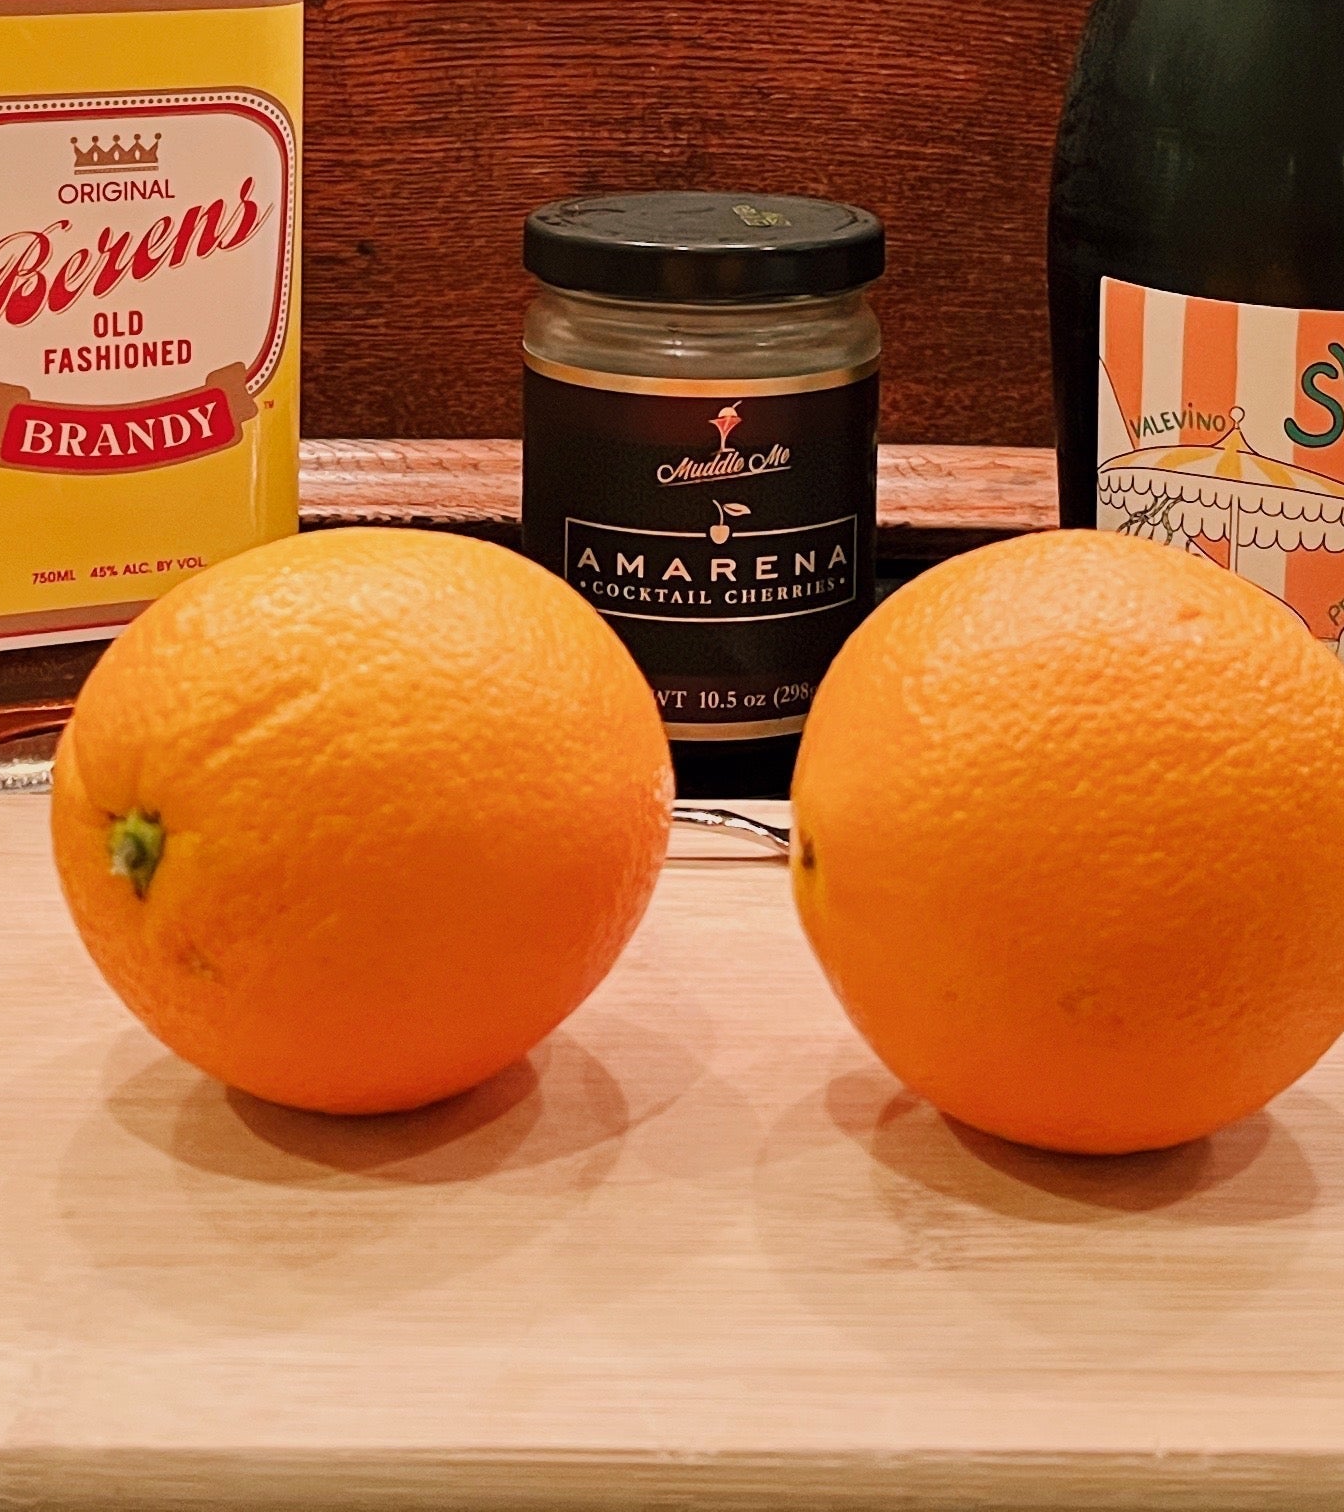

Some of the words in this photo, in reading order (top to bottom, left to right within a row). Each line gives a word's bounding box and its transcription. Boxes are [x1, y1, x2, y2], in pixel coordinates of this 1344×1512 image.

[58, 178, 175, 204] ORIGINAL
[93, 310, 143, 338] OLD
[44, 339, 192, 375] FASHIONED
[19, 401, 218, 457] BRANDY
[657, 451, 744, 484] Muddle
[748, 443, 790, 473] Me
[32, 569, 76, 584] 750ML
[90, 565, 118, 578] 45%
[157, 560, 173, 572] BY
[577, 544, 848, 583] AMARENA
[592, 580, 712, 606] COCKTAIL
[724, 576, 836, 605] CHERRIES
[699, 691, 737, 709] 10.5
[743, 694, 766, 707] oz
